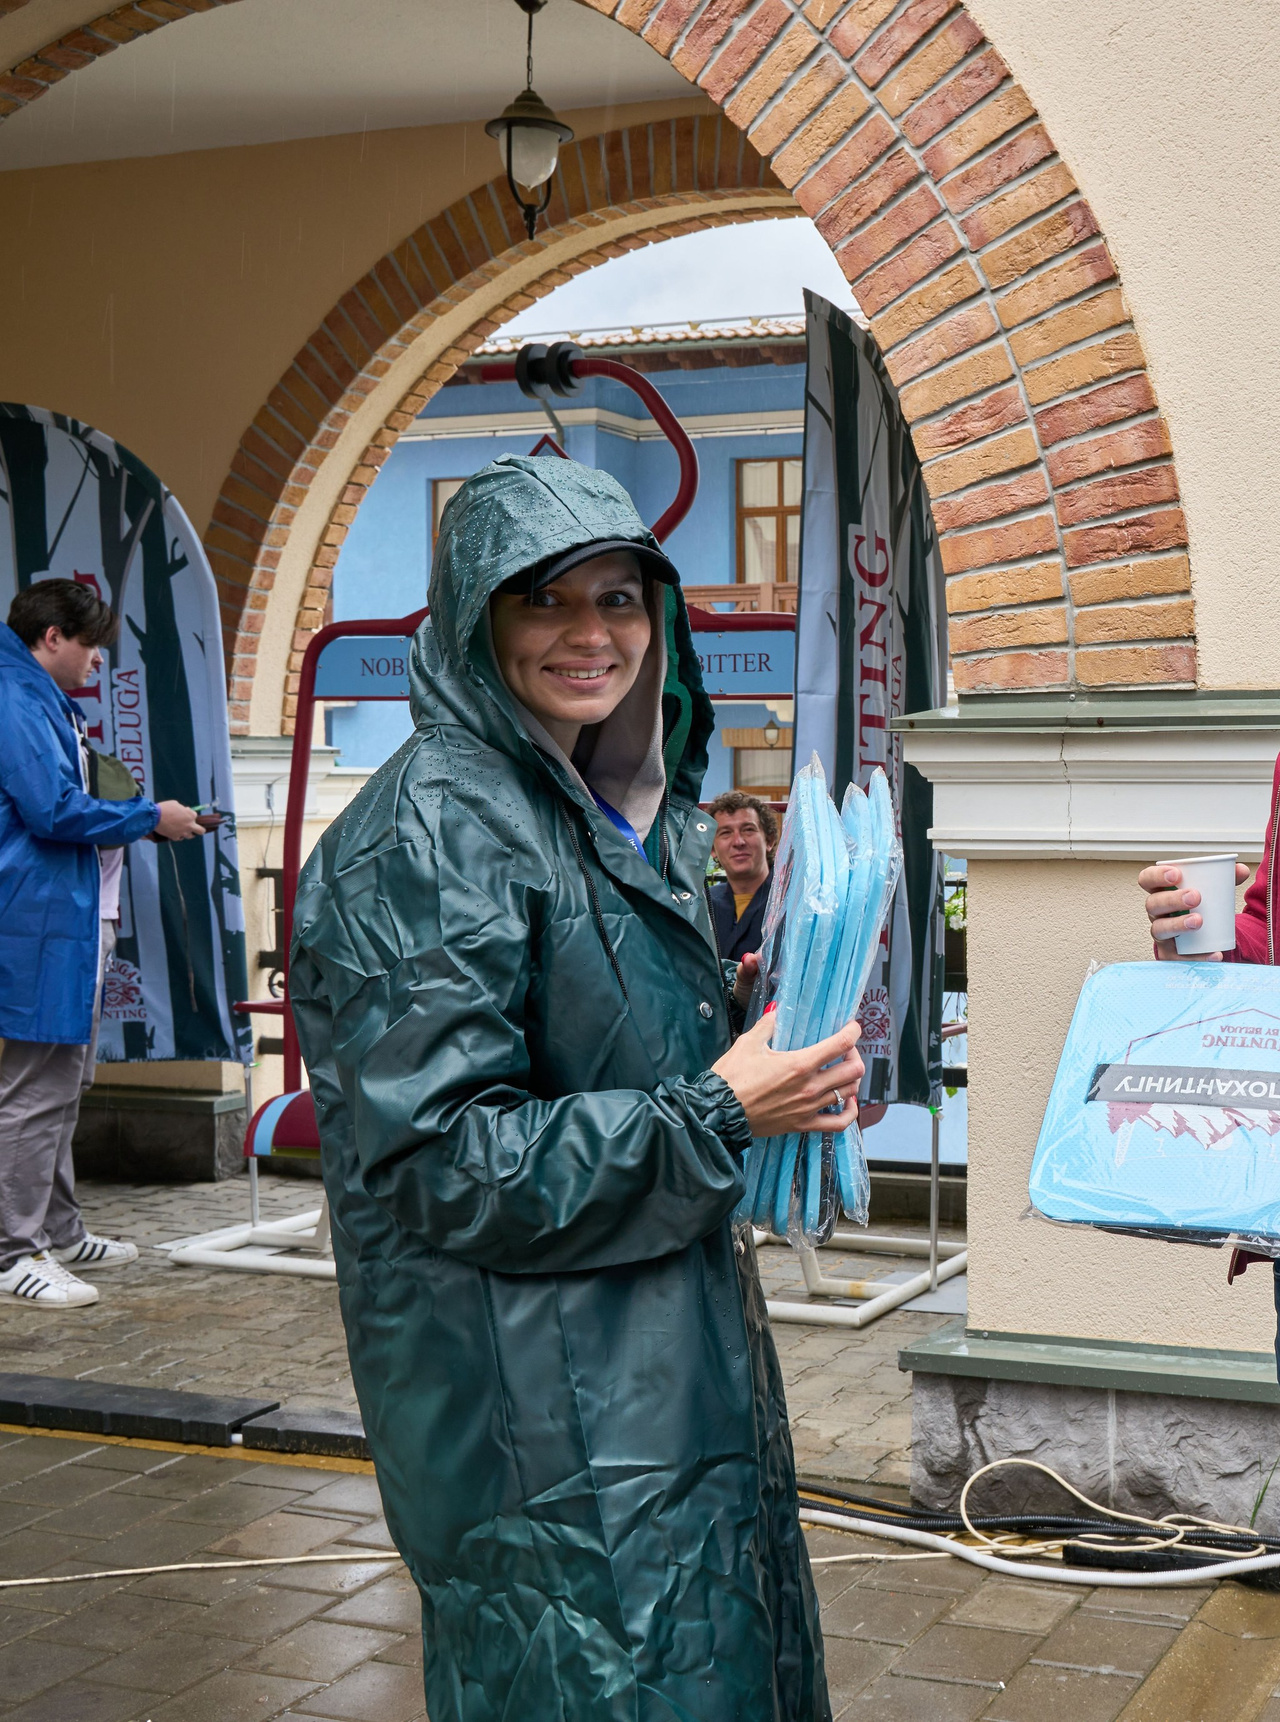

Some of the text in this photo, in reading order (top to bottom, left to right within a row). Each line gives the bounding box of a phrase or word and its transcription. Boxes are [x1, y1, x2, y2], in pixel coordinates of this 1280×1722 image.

[854, 531, 890, 796] TING
[103, 1007, 147, 1019] NTING
[1220, 1025, 1279, 1036] BY BELUGA
[858, 1043, 892, 1056] NTING
